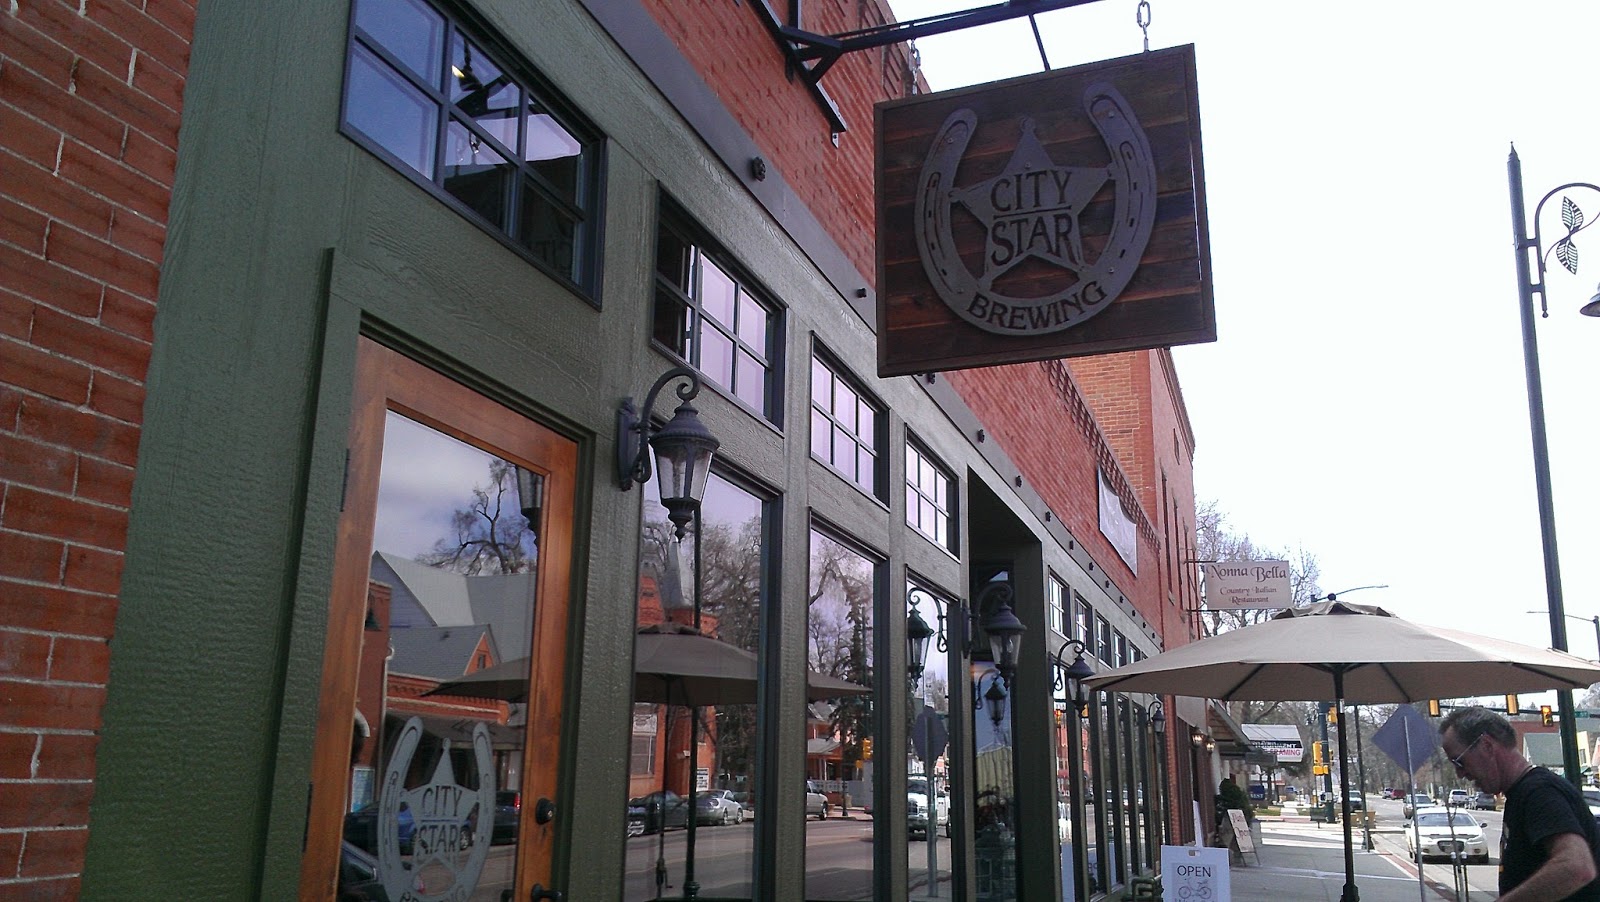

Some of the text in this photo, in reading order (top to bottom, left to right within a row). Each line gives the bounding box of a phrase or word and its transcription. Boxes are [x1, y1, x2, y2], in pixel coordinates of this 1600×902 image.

[990, 170, 1072, 211] CITY
[990, 213, 1078, 266] STAR
[966, 280, 1108, 330] BREWING
[1206, 565, 1287, 582] Nonna Bella
[1220, 586, 1277, 596] Country Italian
[1229, 596, 1269, 605] Restaurant
[422, 785, 462, 817] CITY
[418, 824, 459, 854] STAR
[1177, 865, 1212, 878] OPEN
